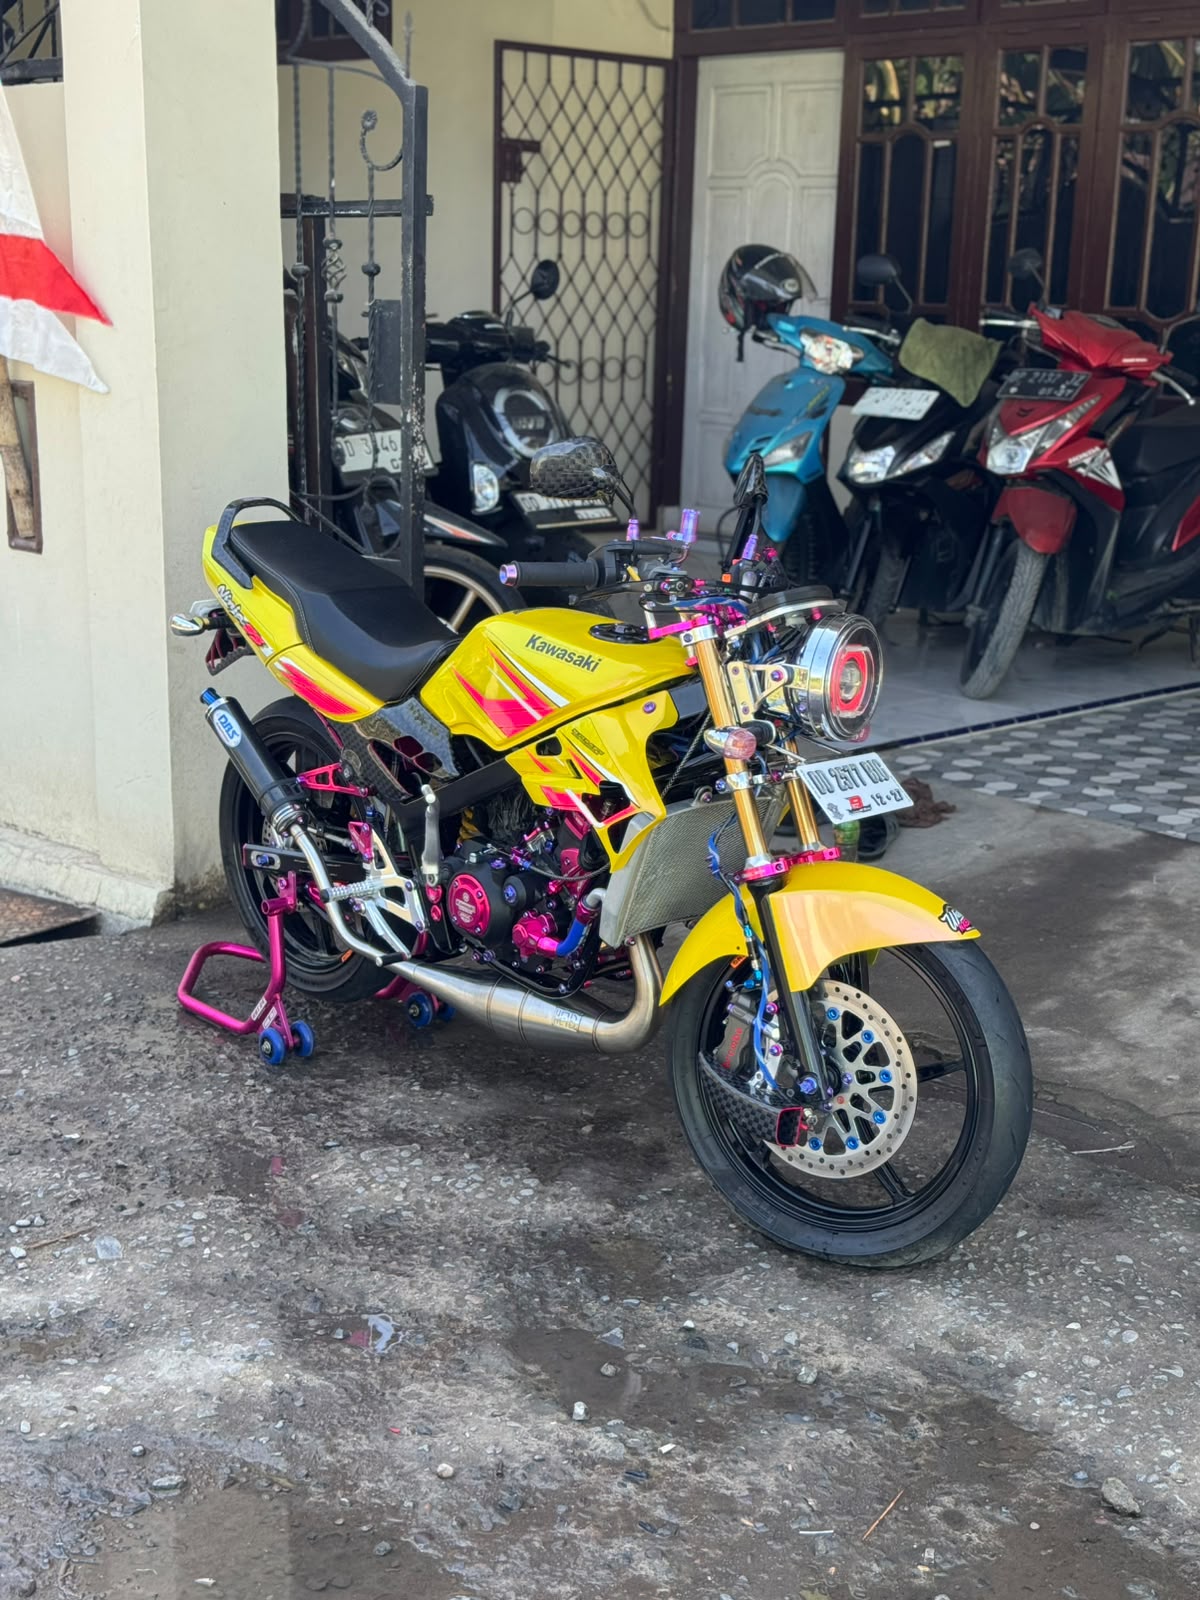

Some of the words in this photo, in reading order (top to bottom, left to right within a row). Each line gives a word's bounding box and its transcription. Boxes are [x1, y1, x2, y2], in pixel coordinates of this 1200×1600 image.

[361, 435, 398, 456] 346
[525, 633, 602, 673] Kawasaki
[807, 769, 835, 795] DD
[828, 763, 867, 792] 2577
